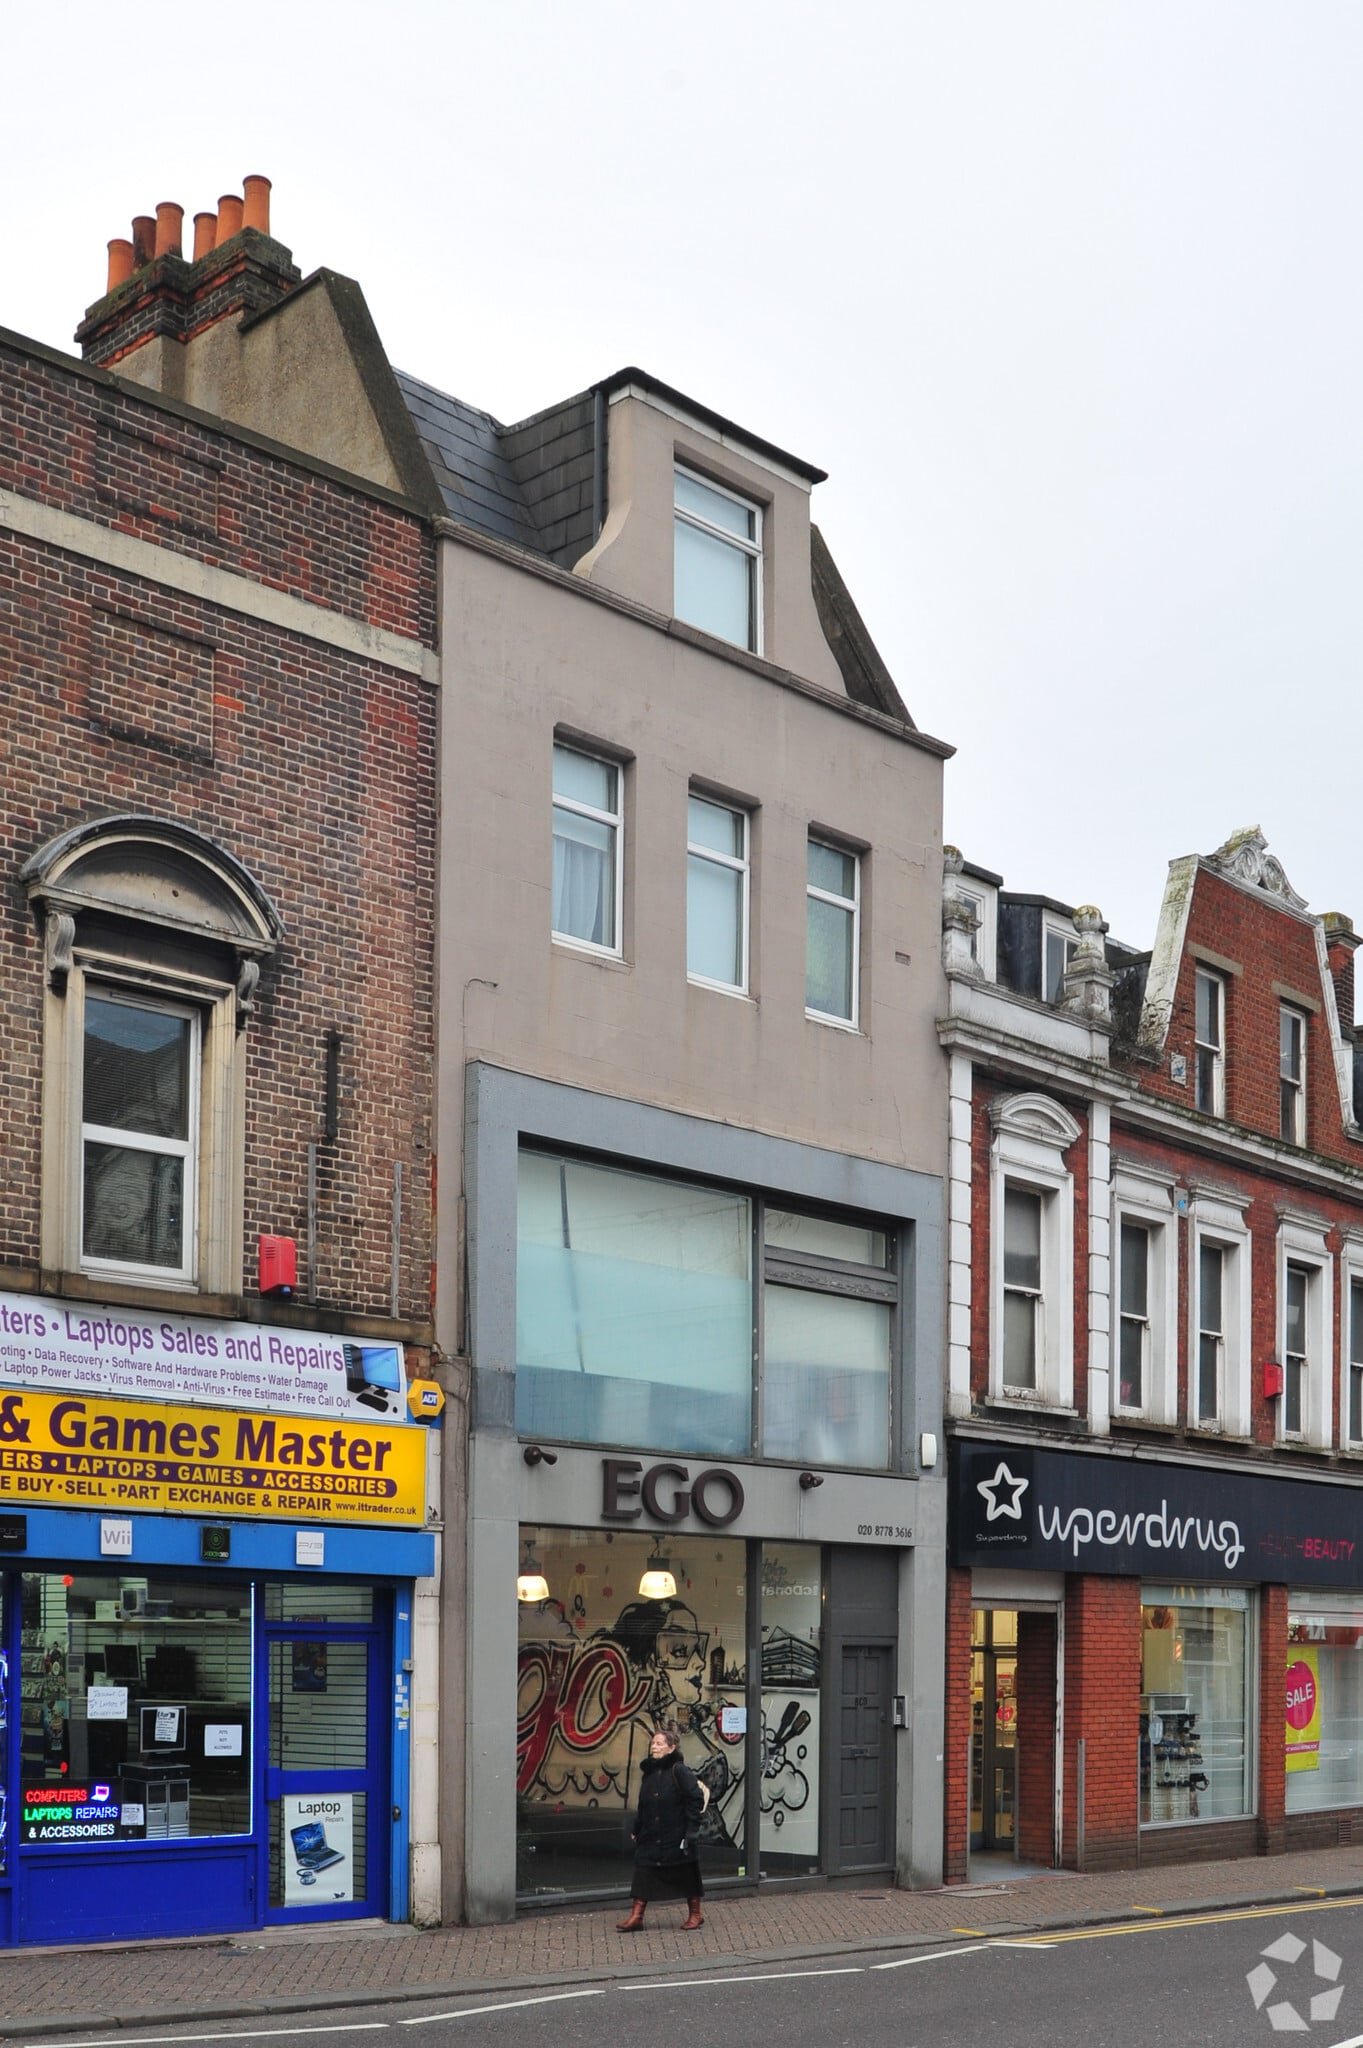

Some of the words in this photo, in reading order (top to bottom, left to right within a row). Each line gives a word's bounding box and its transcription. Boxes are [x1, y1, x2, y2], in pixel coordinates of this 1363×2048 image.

[0, 1305, 46, 1337] ters
[65, 1311, 154, 1354] Laptops
[160, 1323, 219, 1358] Sales
[225, 1335, 263, 1362] and
[268, 1337, 344, 1373] Repairs
[34, 1348, 57, 1361] Data
[60, 1350, 104, 1368] Recovery
[111, 1357, 152, 1372] Software
[155, 1362, 173, 1374] And
[175, 1364, 218, 1379] Hardware
[220, 1369, 261, 1383] Problems
[268, 1374, 292, 1387] Water
[295, 1377, 328, 1393] Damage
[4, 1361, 38, 1377] Laptop
[41, 1366, 71, 1379] Power
[74, 1368, 102, 1382] Jacks
[109, 1373, 133, 1385] Virus
[136, 1375, 175, 1390] Removal
[183, 1380, 226, 1395] Anti-Virus
[233, 1386, 252, 1398] Free
[254, 1388, 290, 1402] Estimate
[298, 1393, 316, 1405] Free
[318, 1395, 334, 1407] Call
[336, 1397, 351, 1409] Out
[422, 1393, 438, 1405] ADT
[0, 1395, 31, 1443] &
[49, 1401, 220, 1459] Games
[235, 1418, 392, 1471] Master
[2, 1452, 43, 1470] ERS
[65, 1456, 157, 1478] LAPTOPS
[178, 1465, 244, 1483] GAMES
[263, 1472, 388, 1496] ACCESSORIES
[17, 1476, 55, 1493] BUY
[65, 1480, 107, 1497] SELL
[118, 1483, 160, 1500] PART
[168, 1487, 256, 1506] EXCHANGE
[261, 1494, 272, 1507] &
[278, 1495, 332, 1511] REPAIR
[335, 1502, 417, 1515] www.ittrader.co.uk
[601, 1459, 745, 1526] EGO
[103, 1530, 131, 1546] Wii
[857, 1524, 873, 1536] 020
[874, 1525, 893, 1537] 8778
[1304, 1537, 1355, 1560] BEAUTY
[1286, 1682, 1313, 1709] SALE
[25, 1789, 88, 1803] COMPUTERS
[298, 1801, 341, 1816] Laptop
[24, 1807, 73, 1821] LAPTOPS
[75, 1806, 119, 1819] REPAIRS
[28, 1827, 37, 1838] &
[40, 1824, 115, 1838] ACCESSORIES
